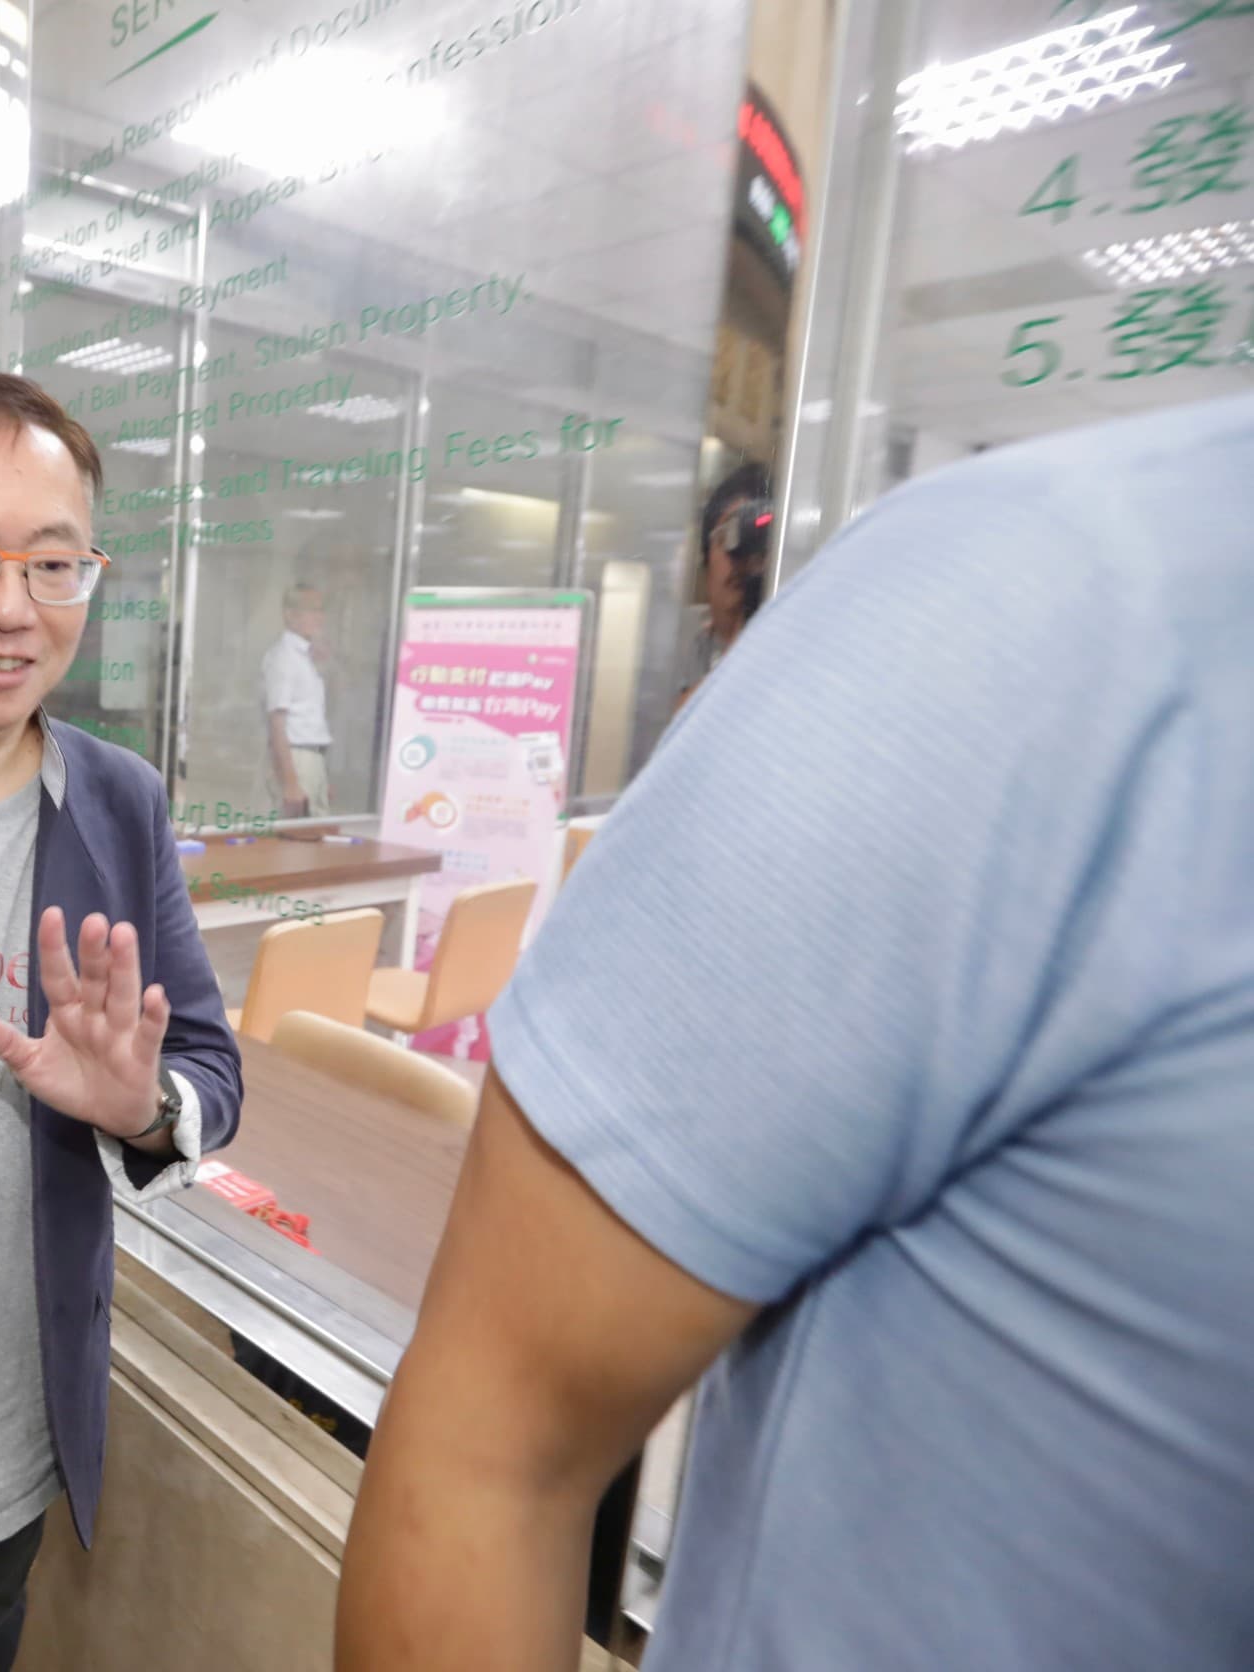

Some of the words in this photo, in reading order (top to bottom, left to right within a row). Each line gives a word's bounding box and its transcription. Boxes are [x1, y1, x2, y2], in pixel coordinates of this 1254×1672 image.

[178, 253, 290, 313] Payment
[254, 320, 349, 368] Stolen
[358, 271, 537, 344] Property.
[229, 371, 356, 422] Property
[219, 462, 270, 499] and
[281, 444, 430, 491] Traveling
[444, 425, 542, 469] Fees
[560, 411, 626, 453] for
[215, 801, 280, 837] Brief
[209, 871, 324, 927] Services
